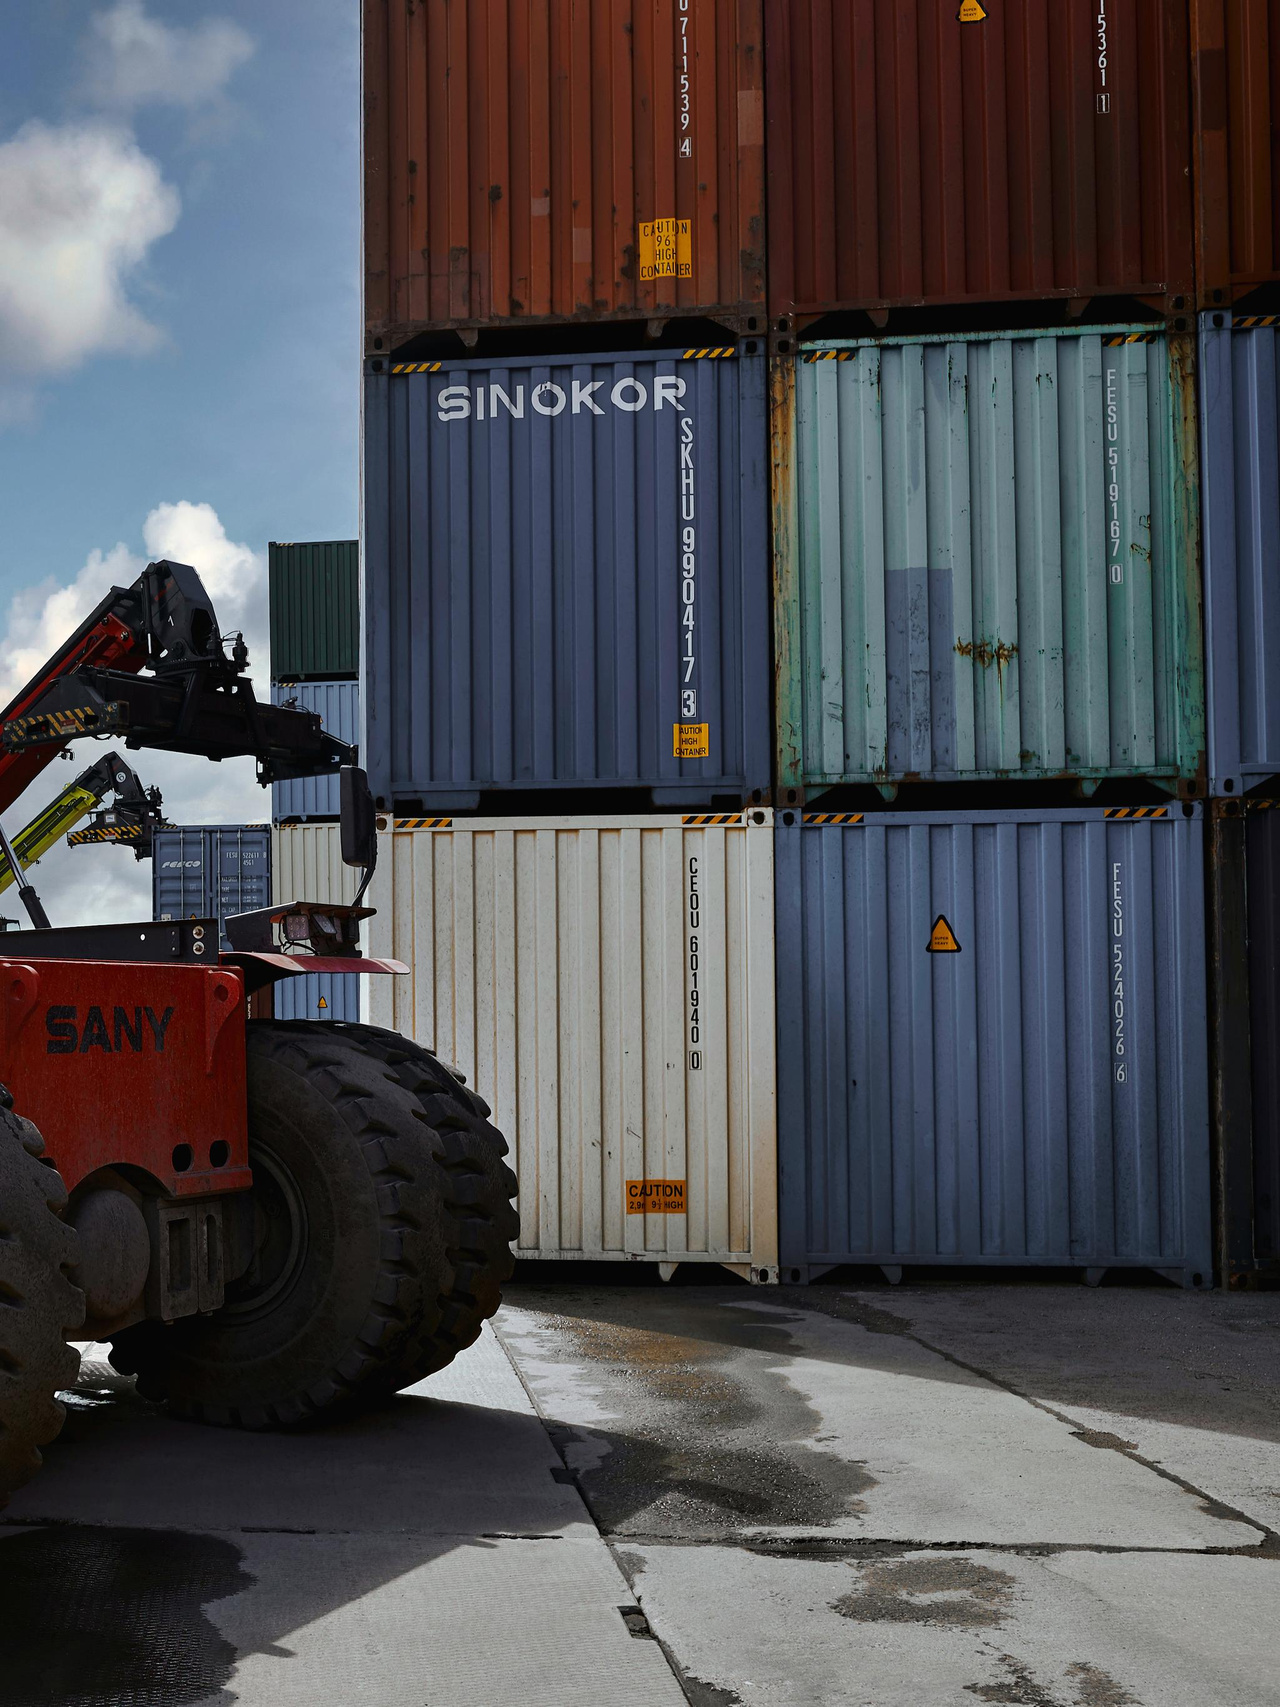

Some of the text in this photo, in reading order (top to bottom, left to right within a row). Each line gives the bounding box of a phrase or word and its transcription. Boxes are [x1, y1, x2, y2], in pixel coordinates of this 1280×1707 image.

[679, 17, 690, 130] 711539
[680, 138, 690, 156] 4
[643, 220, 687, 237] CAUTION
[655, 247, 677, 260] HIGH
[438, 376, 686, 421] SINOKOR
[1106, 369, 1117, 442] FESU
[1109, 447, 1120, 557] 519167
[681, 417, 696, 717] SKHU 990417 3
[679, 726, 702, 735] AUTION
[681, 737, 698, 745] HIGH
[689, 857, 699, 928] CEOU
[690, 935, 699, 1043] 601940
[1113, 863, 1126, 1082] FESU 524026 6
[45, 1005, 175, 1054] SANY
[629, 1184, 683, 1197] CAUTION
[664, 1201, 684, 1209] HIGH
